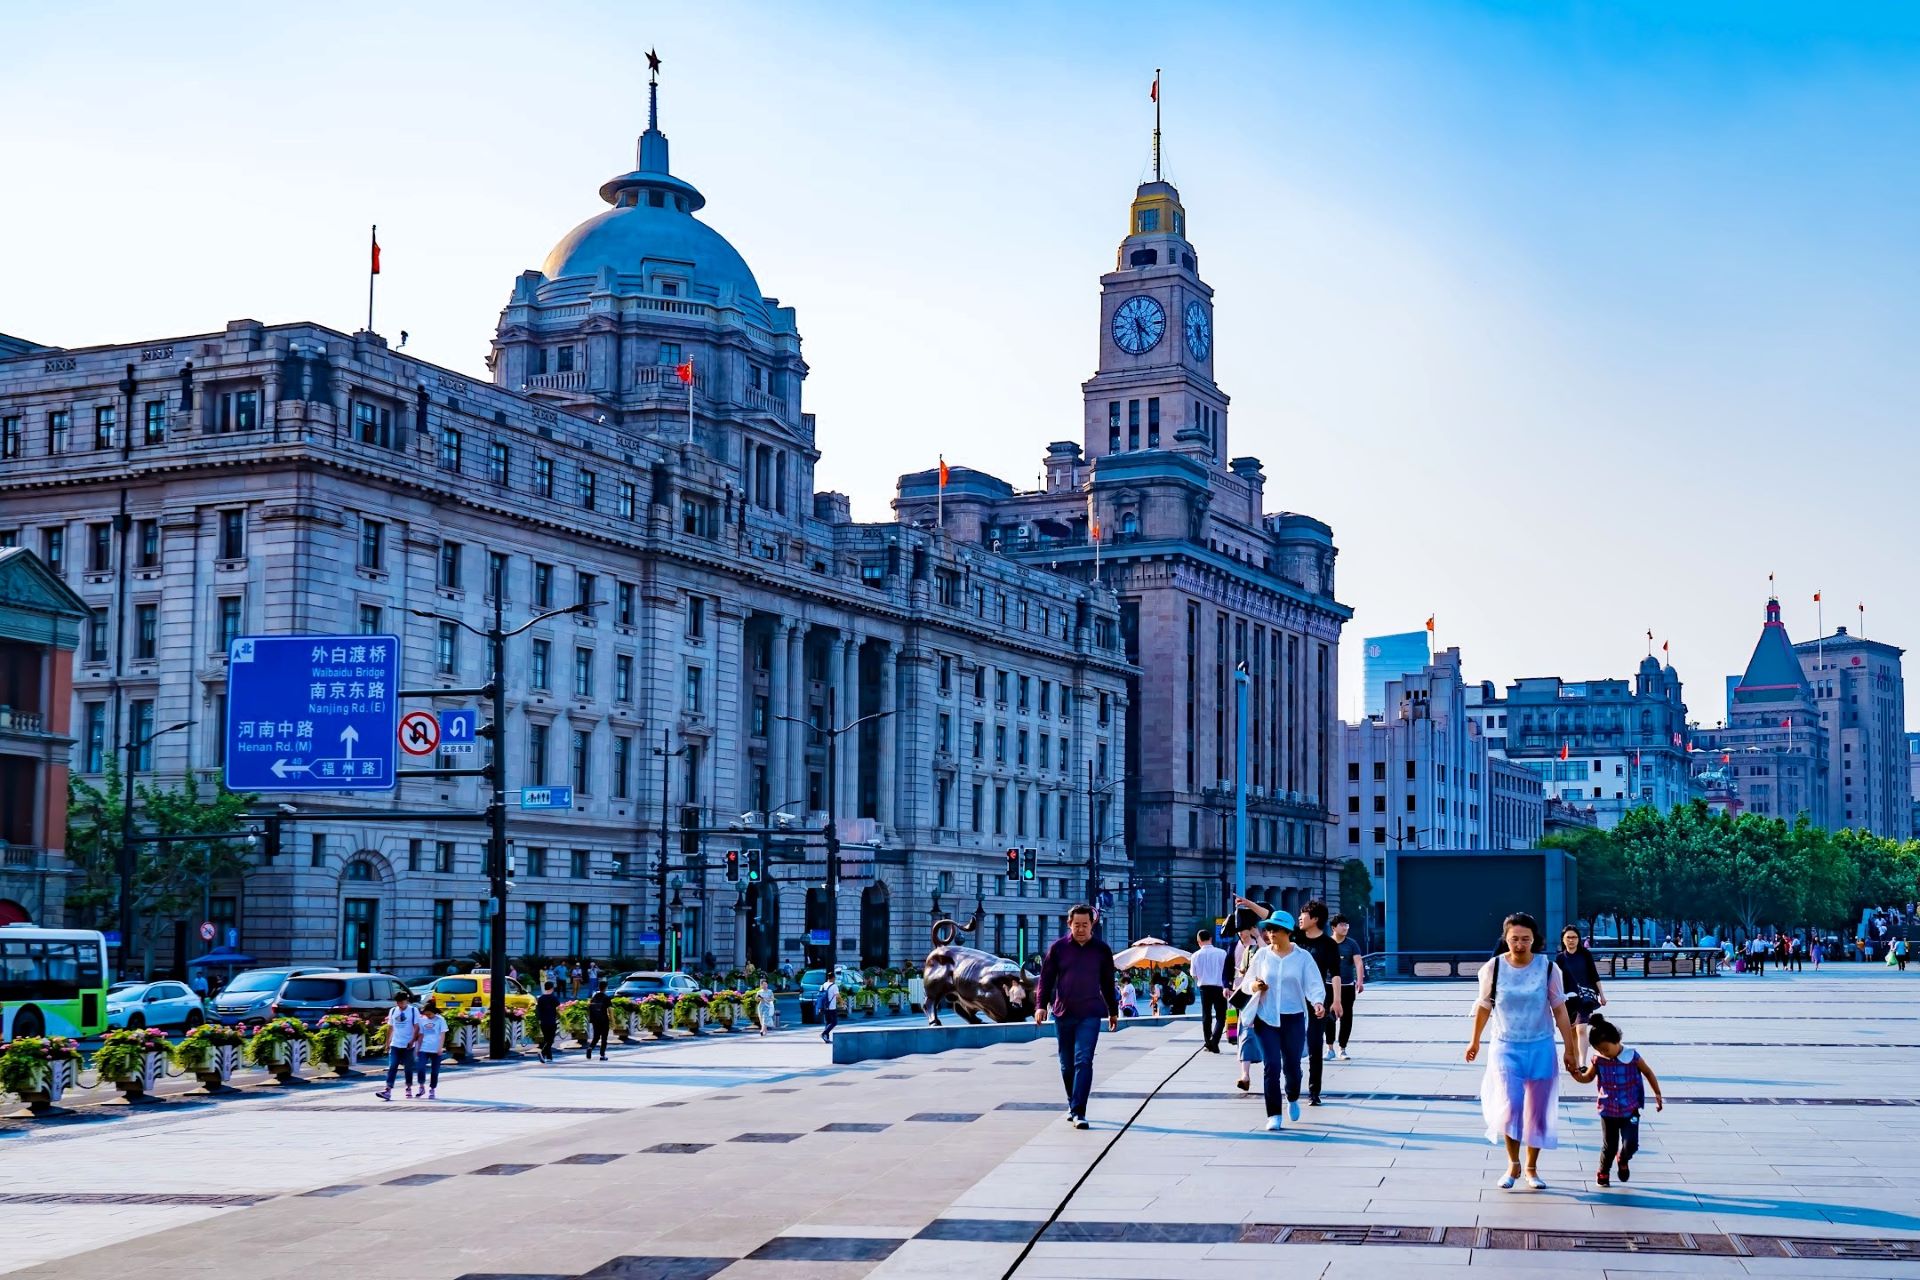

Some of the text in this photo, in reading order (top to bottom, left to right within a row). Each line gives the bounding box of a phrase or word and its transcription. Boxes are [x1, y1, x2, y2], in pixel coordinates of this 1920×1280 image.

[241, 642, 252, 654] 北
[311, 645, 387, 664] 外白渡桥
[312, 667, 385, 679] Waibaidu Bridge
[309, 681, 385, 699] 南京东路
[308, 702, 386, 715] Nanjing Rd. (E)
[238, 720, 314, 738] 河南中路
[238, 741, 312, 753] Henan Rd. (M)
[321, 761, 376, 776] 福州路
